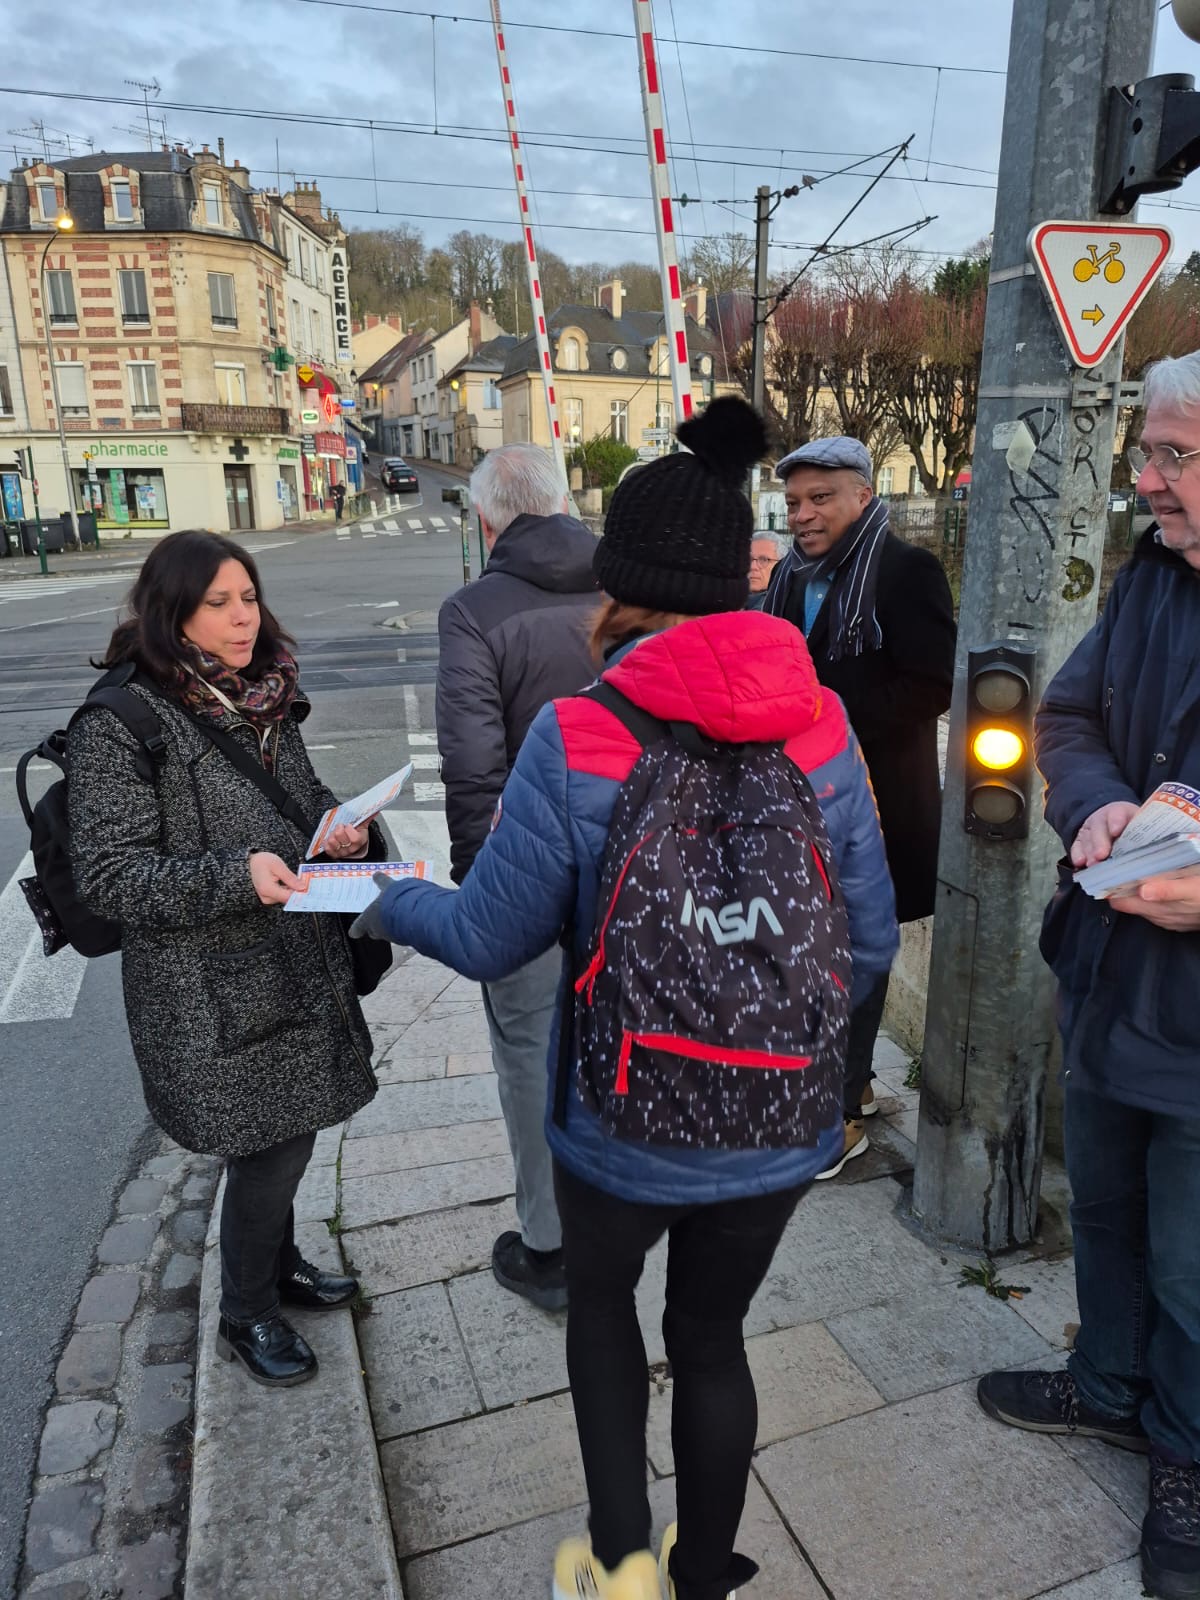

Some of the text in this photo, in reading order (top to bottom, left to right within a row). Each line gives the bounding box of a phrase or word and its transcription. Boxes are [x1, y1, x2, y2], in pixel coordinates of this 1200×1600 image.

[332, 252, 349, 349] AGENCE
[90, 441, 168, 458] pharmacie
[954, 489, 963, 499] 22
[680, 888, 785, 946] NASA
